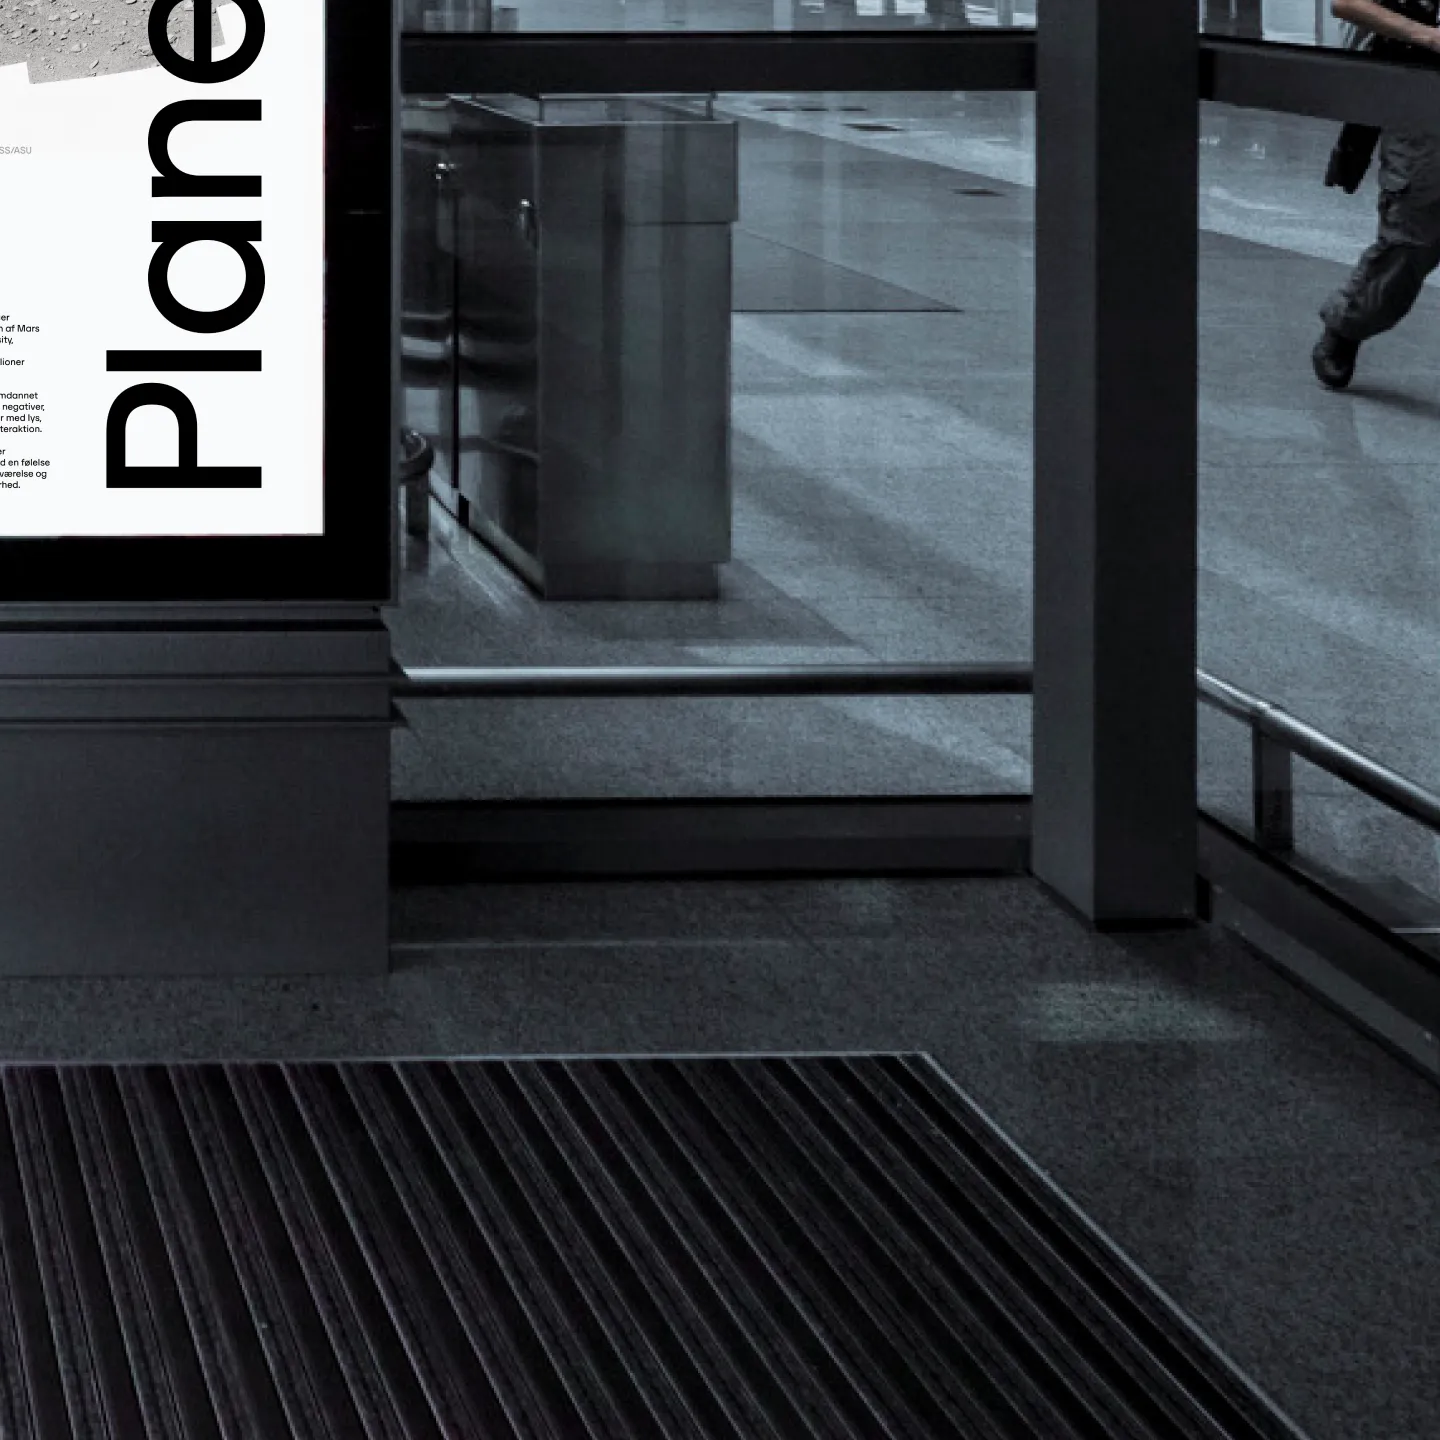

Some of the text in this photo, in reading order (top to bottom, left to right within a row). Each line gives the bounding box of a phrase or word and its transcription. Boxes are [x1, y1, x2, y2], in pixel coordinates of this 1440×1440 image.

[5, 324, 16, 333] af
[16, 324, 40, 333] Mars
[2, 402, 45, 413] negativer,
[5, 413, 26, 422] med
[27, 413, 42, 424] lys,
[7, 459, 20, 467] en
[20, 458, 51, 467] følelse
[35, 470, 48, 480] og
